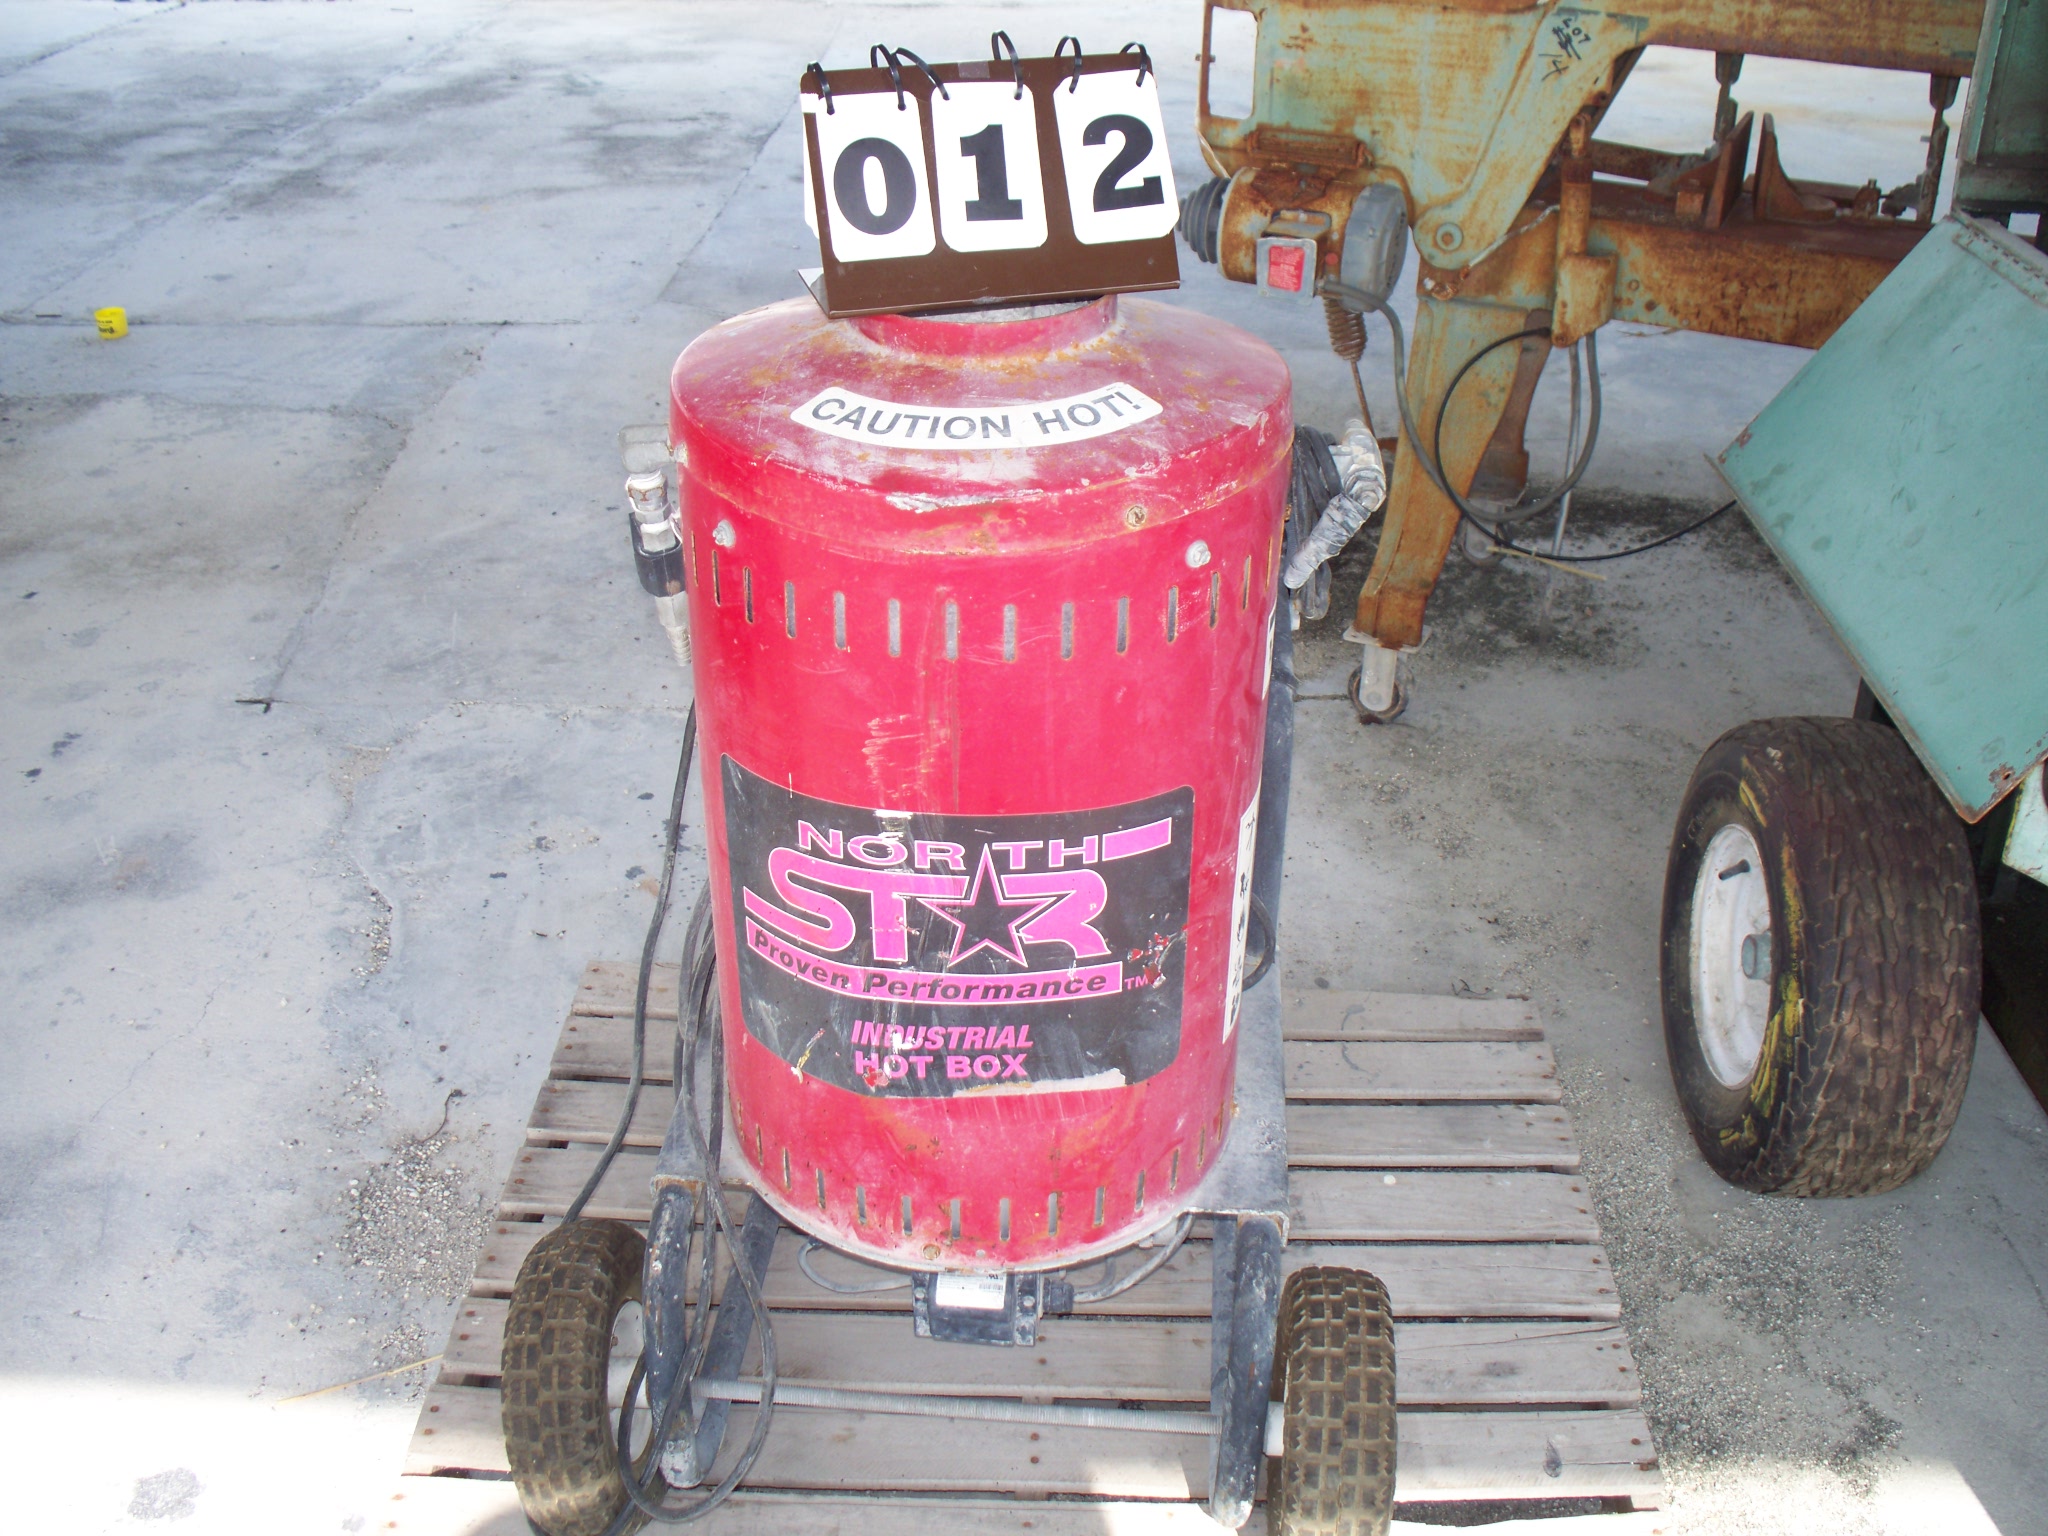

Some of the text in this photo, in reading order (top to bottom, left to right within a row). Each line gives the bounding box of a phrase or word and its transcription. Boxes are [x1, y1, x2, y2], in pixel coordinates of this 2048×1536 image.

[833, 113, 1165, 236] 012
[810, 391, 1143, 440] CAUTION HOT!
[798, 819, 1100, 870] NORTH
[753, 928, 849, 989] Proven
[866, 971, 1108, 1000] Performance
[851, 1019, 1034, 1050] INDUSTRIAL
[855, 1050, 1028, 1079] HOT BOX
